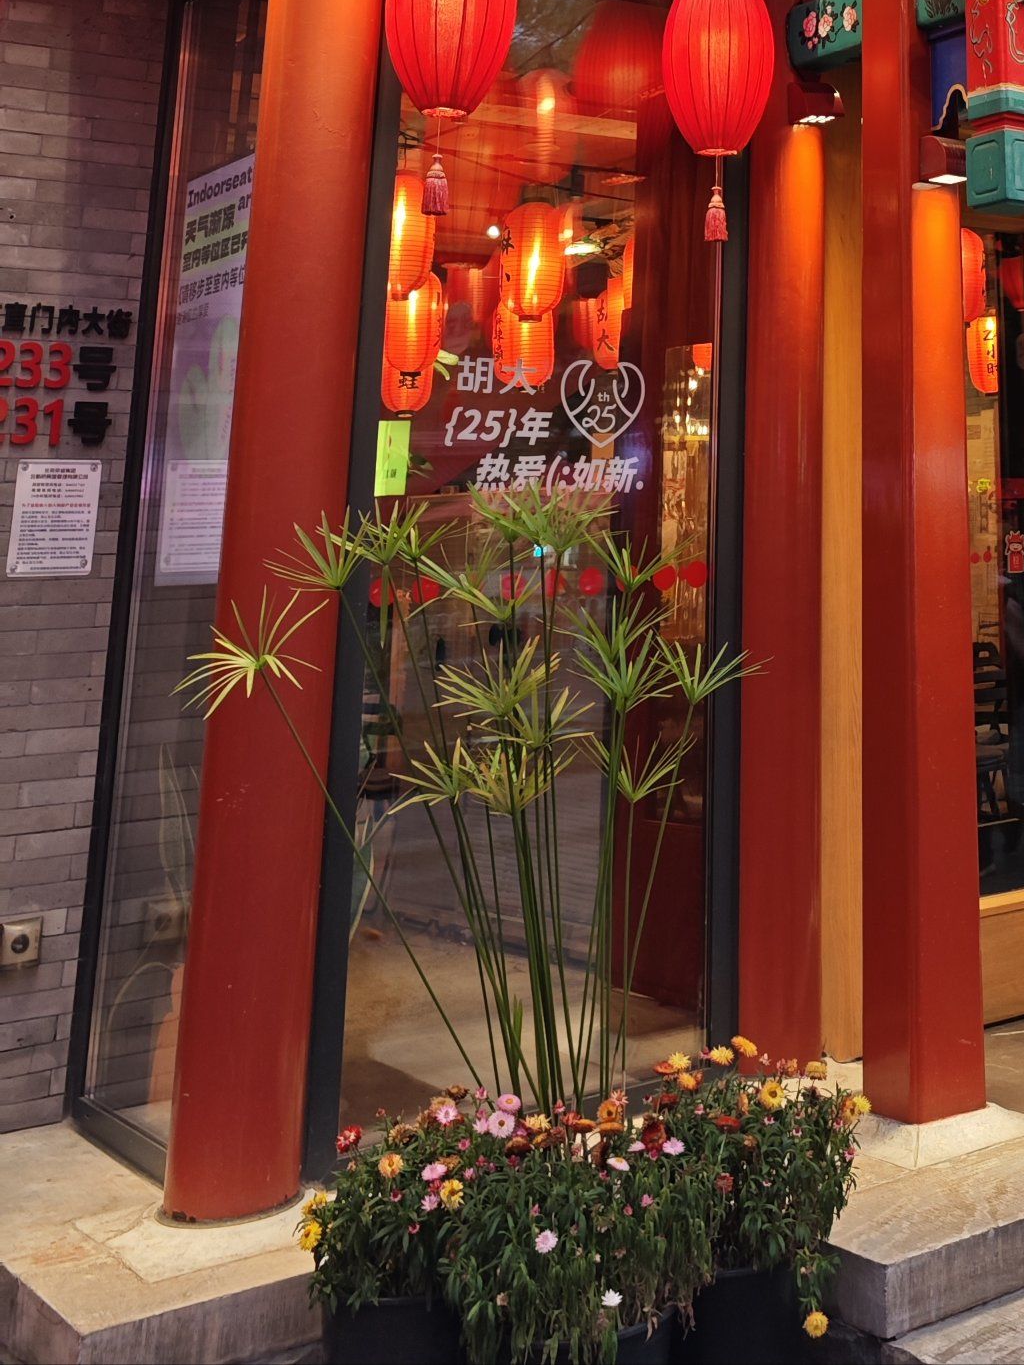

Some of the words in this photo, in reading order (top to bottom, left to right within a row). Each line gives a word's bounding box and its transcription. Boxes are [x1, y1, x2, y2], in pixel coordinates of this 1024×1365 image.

[0, 302, 133, 338] 直门内大街
[456, 355, 538, 396] 胡大
